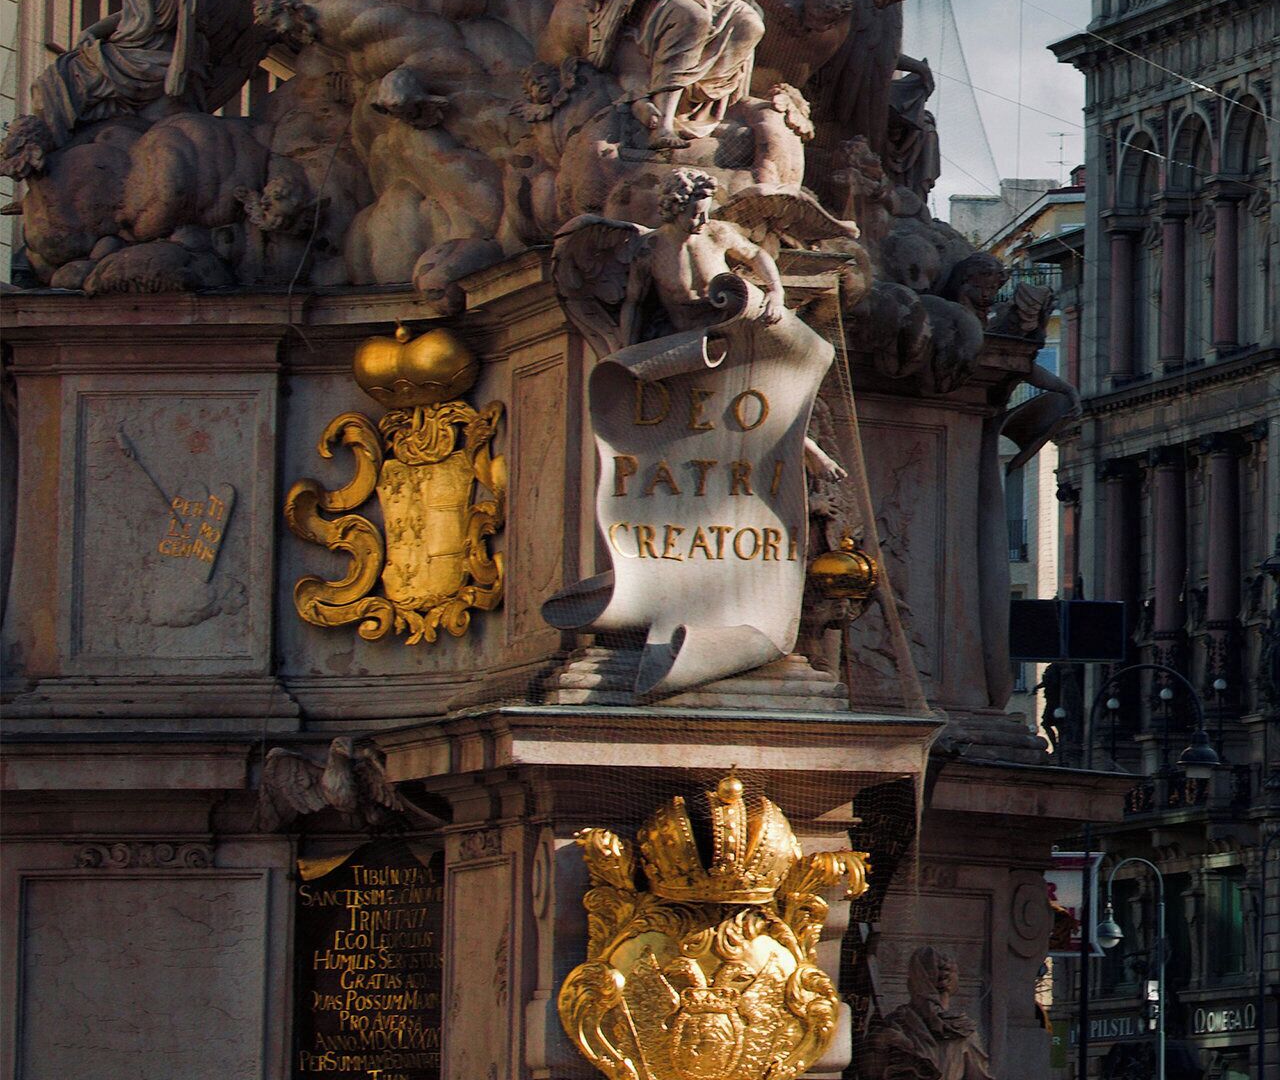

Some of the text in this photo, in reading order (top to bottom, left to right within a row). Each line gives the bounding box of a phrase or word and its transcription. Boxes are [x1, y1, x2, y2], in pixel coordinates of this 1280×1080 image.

[633, 379, 769, 430] DEO
[613, 454, 785, 496] PATRI
[609, 521, 799, 562] CREATORI
[1206, 1009, 1242, 1033] OMEGA
